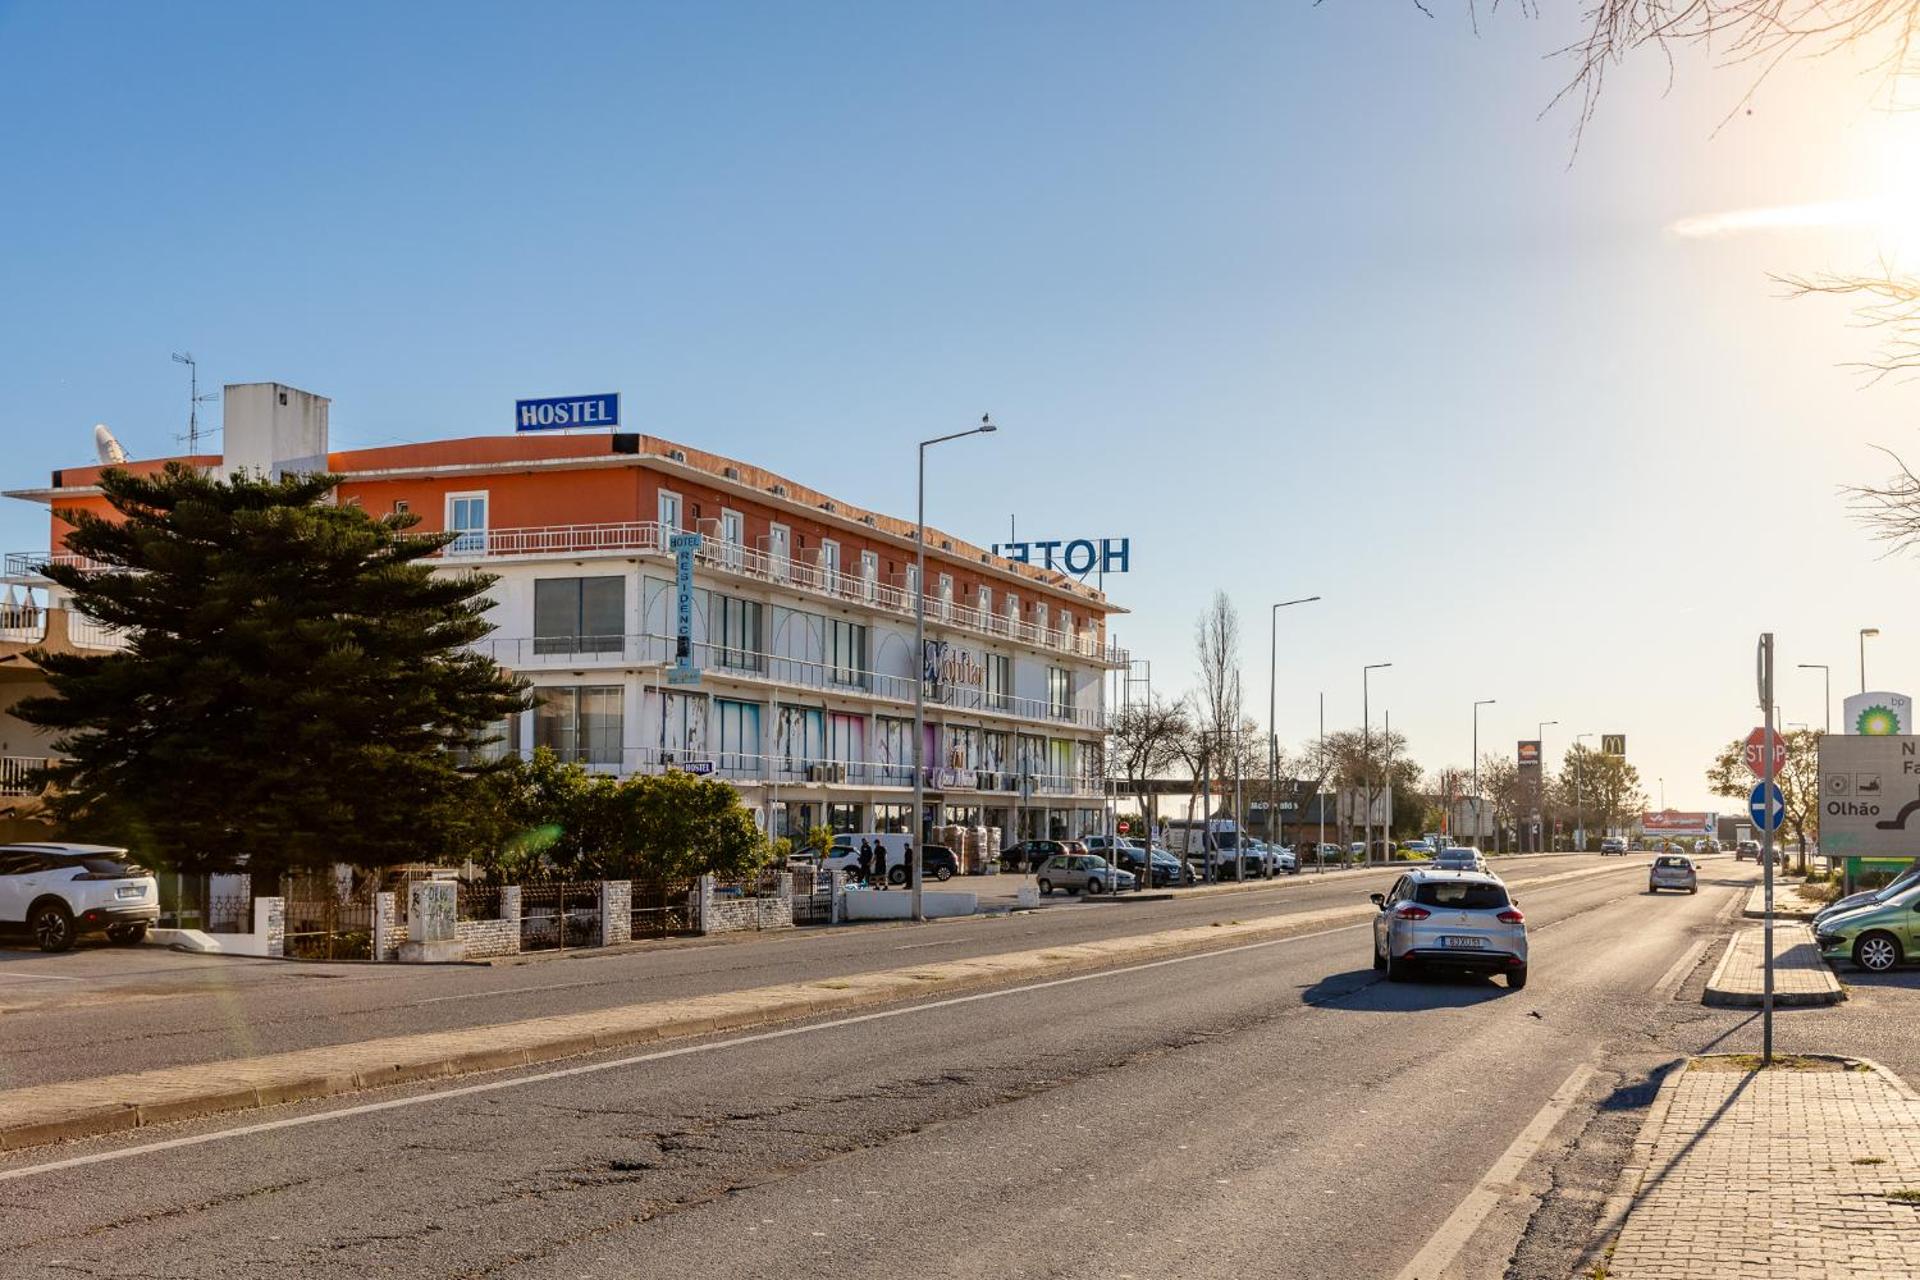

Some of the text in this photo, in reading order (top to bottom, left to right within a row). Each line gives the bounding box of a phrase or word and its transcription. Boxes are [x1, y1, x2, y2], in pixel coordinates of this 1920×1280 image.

[521, 400, 613, 426] HOSTEL
[670, 537, 699, 547] HOTEL
[679, 551, 689, 667] RESIDENCL
[1891, 697, 1905, 708] bp
[1746, 744, 1786, 762] STP
[1902, 742, 1915, 756] N
[685, 763, 710, 772] HOSTEL
[1827, 801, 1880, 816] Olhão
